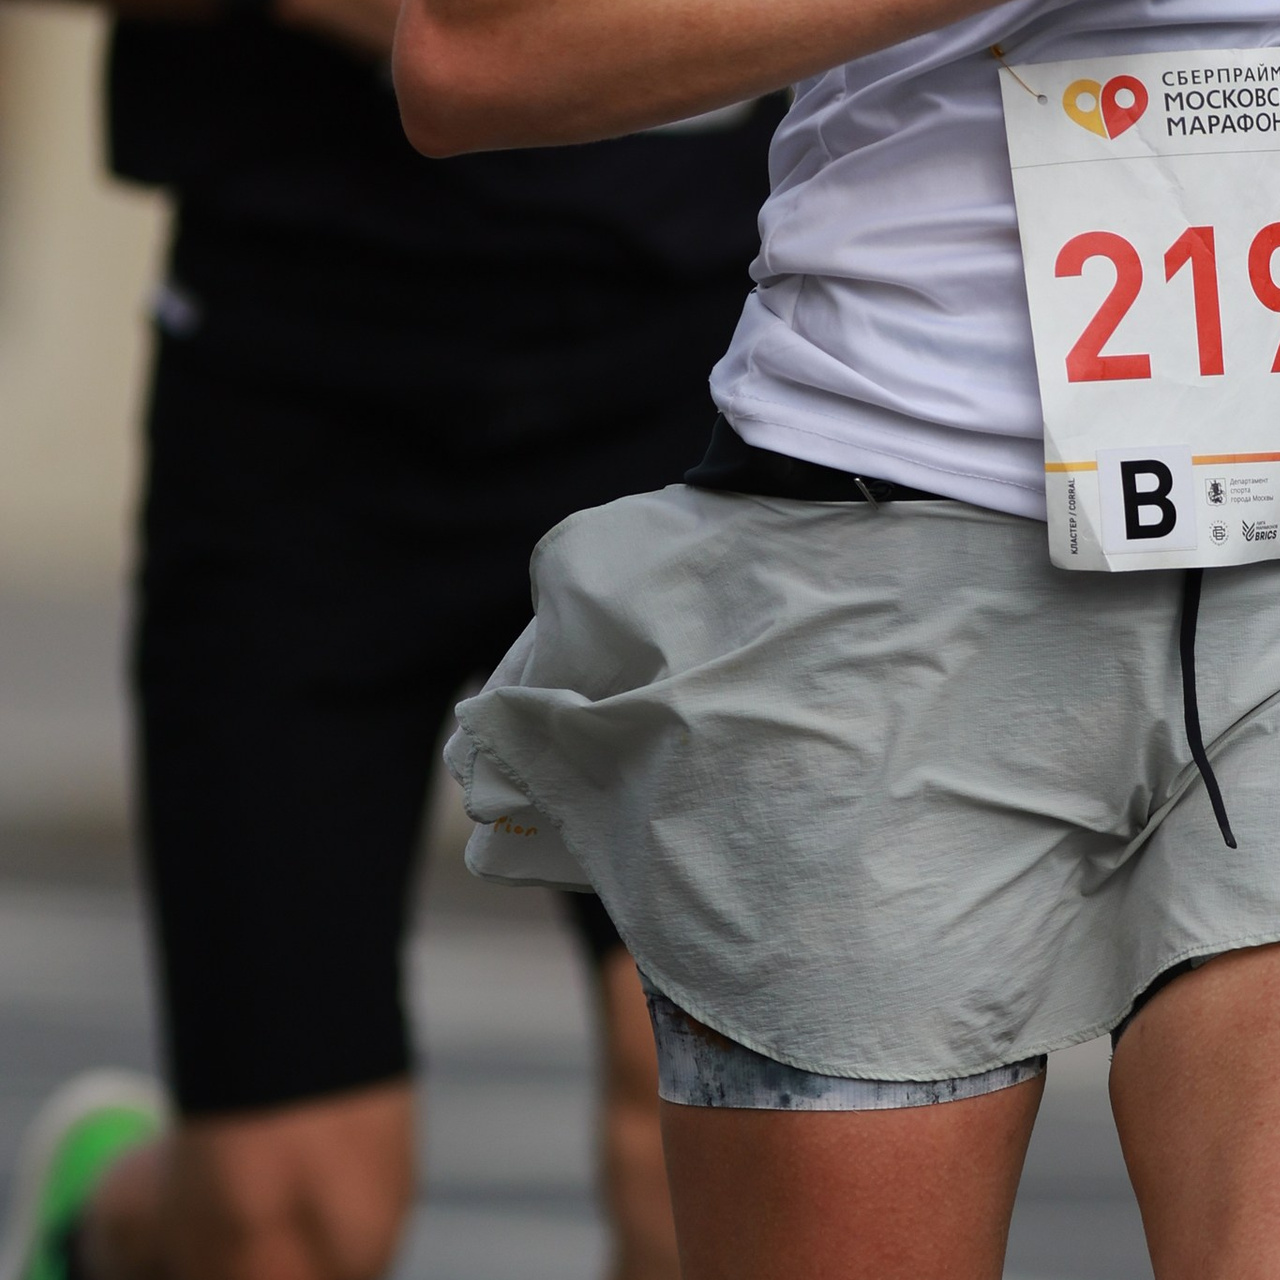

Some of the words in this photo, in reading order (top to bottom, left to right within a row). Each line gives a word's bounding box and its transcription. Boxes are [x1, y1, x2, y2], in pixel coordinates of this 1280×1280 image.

[1068, 478, 1077, 510] CORRAL
[1120, 459, 1177, 540] B
[1069, 517, 1078, 554] КЛАСТЕР
[1255, 530, 1278, 541] BRICS
